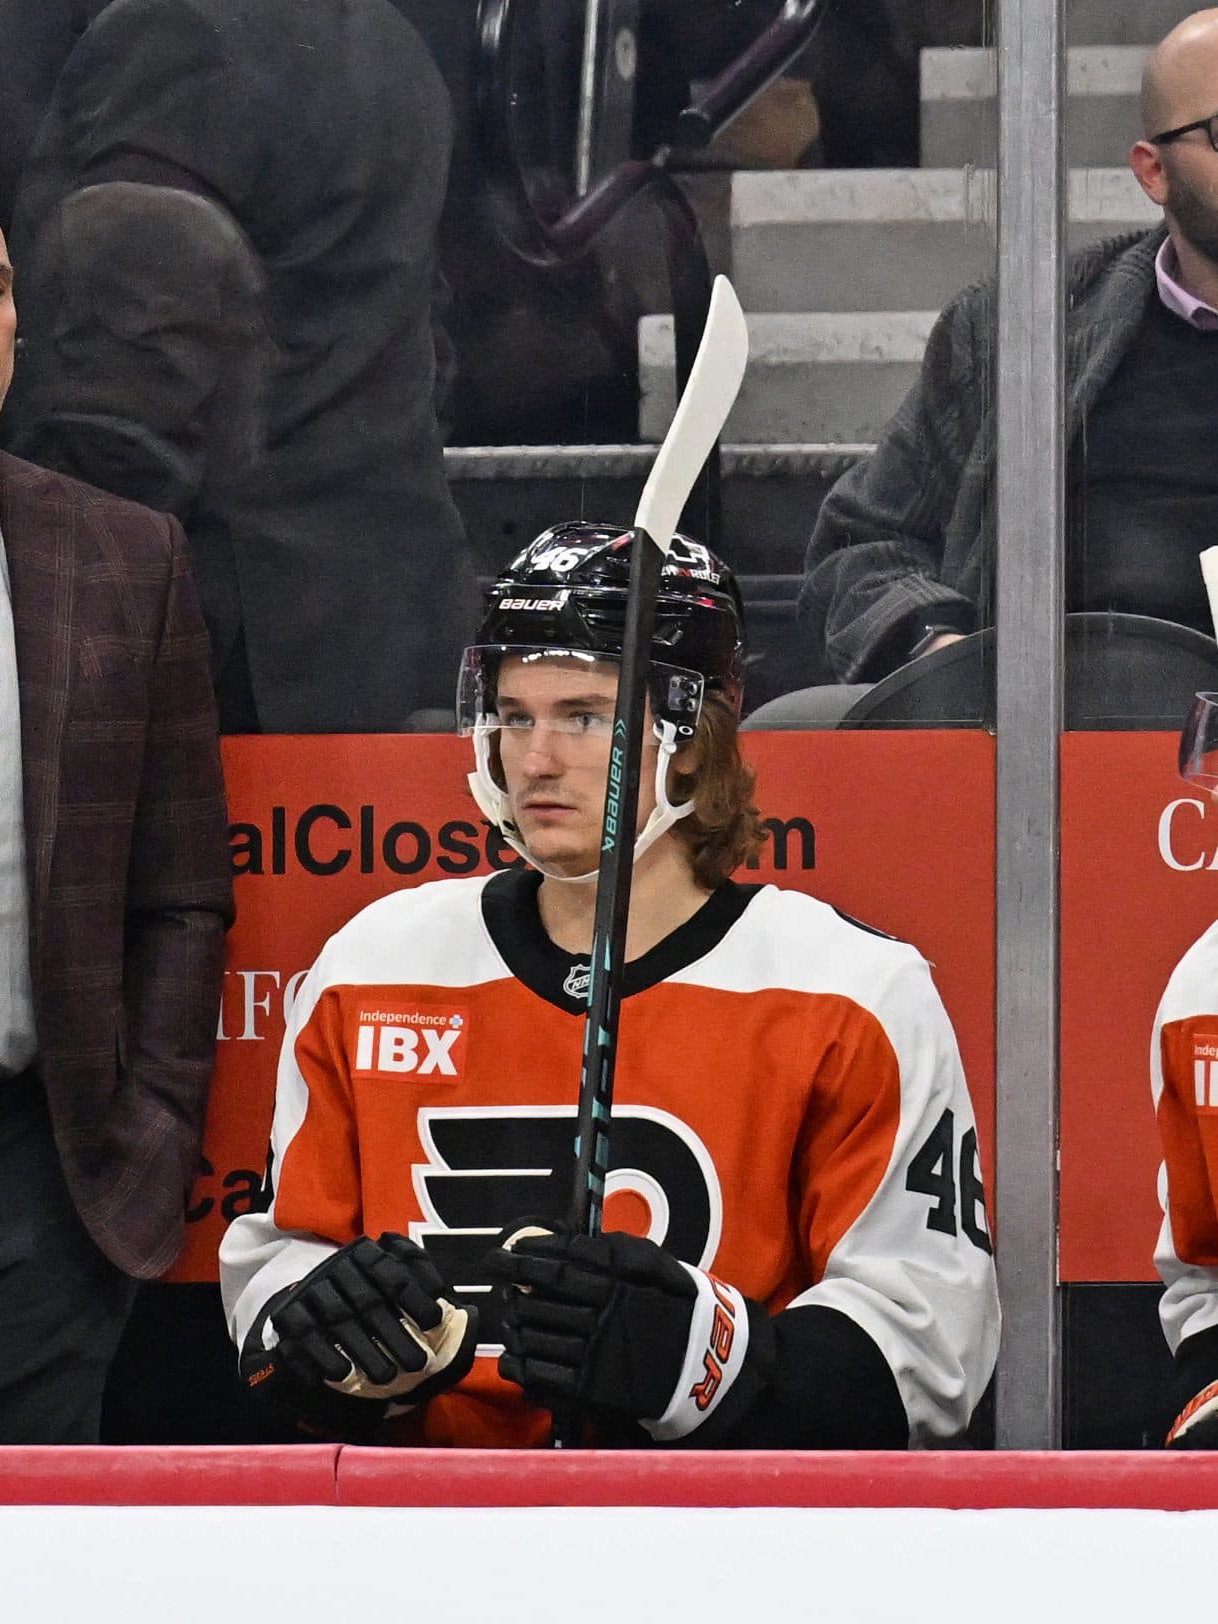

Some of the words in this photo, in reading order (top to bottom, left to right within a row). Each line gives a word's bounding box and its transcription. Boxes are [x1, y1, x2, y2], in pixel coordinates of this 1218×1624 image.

[530, 546, 589, 573] 46
[499, 598, 565, 612] BAUER
[605, 748, 624, 834] BAUER
[1158, 798, 1218, 871] C
[360, 1010, 447, 1026] Independence
[355, 1025, 462, 1076] IBX
